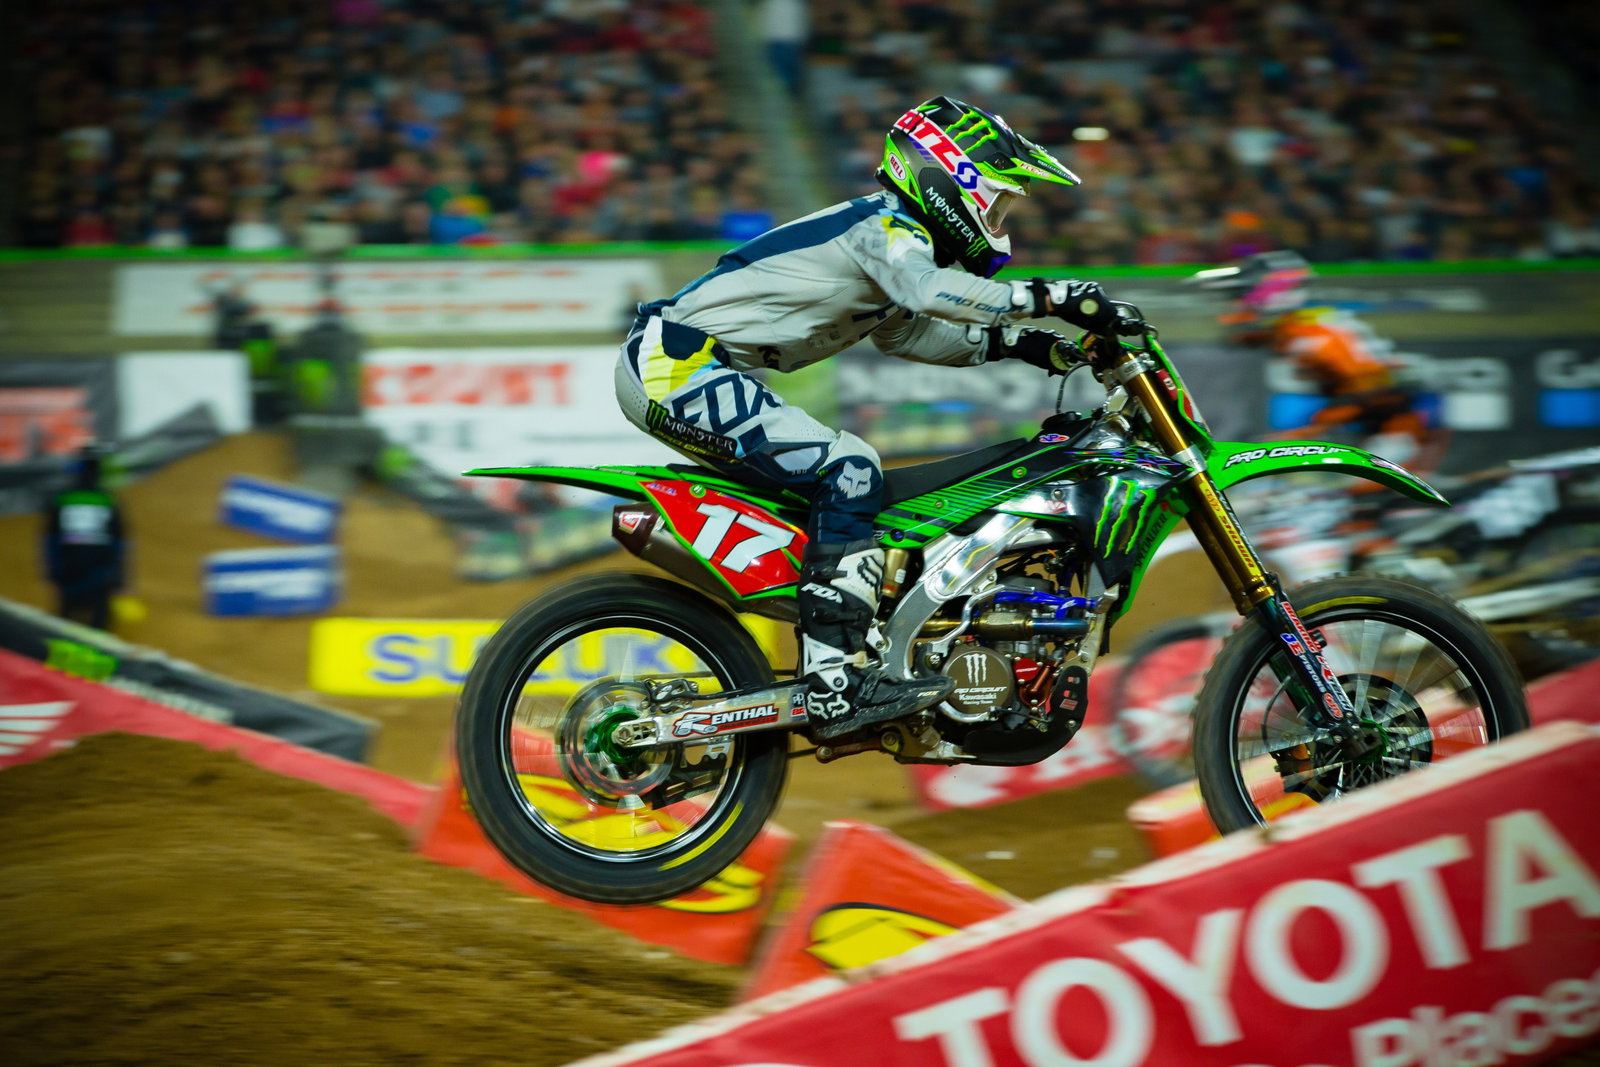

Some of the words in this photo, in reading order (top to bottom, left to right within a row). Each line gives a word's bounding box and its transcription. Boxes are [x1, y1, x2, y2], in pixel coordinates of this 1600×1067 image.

[889, 156, 903, 178] BELL
[925, 186, 976, 244] MONSTER
[664, 417, 734, 452] MONSTER
[1223, 449, 1267, 470] PRO
[691, 502, 796, 575] 17
[800, 582, 843, 604] FOX
[958, 693, 997, 701] Kawasaki
[893, 808, 1600, 1067] TOYOTA
[1351, 968, 1600, 1067] Place
